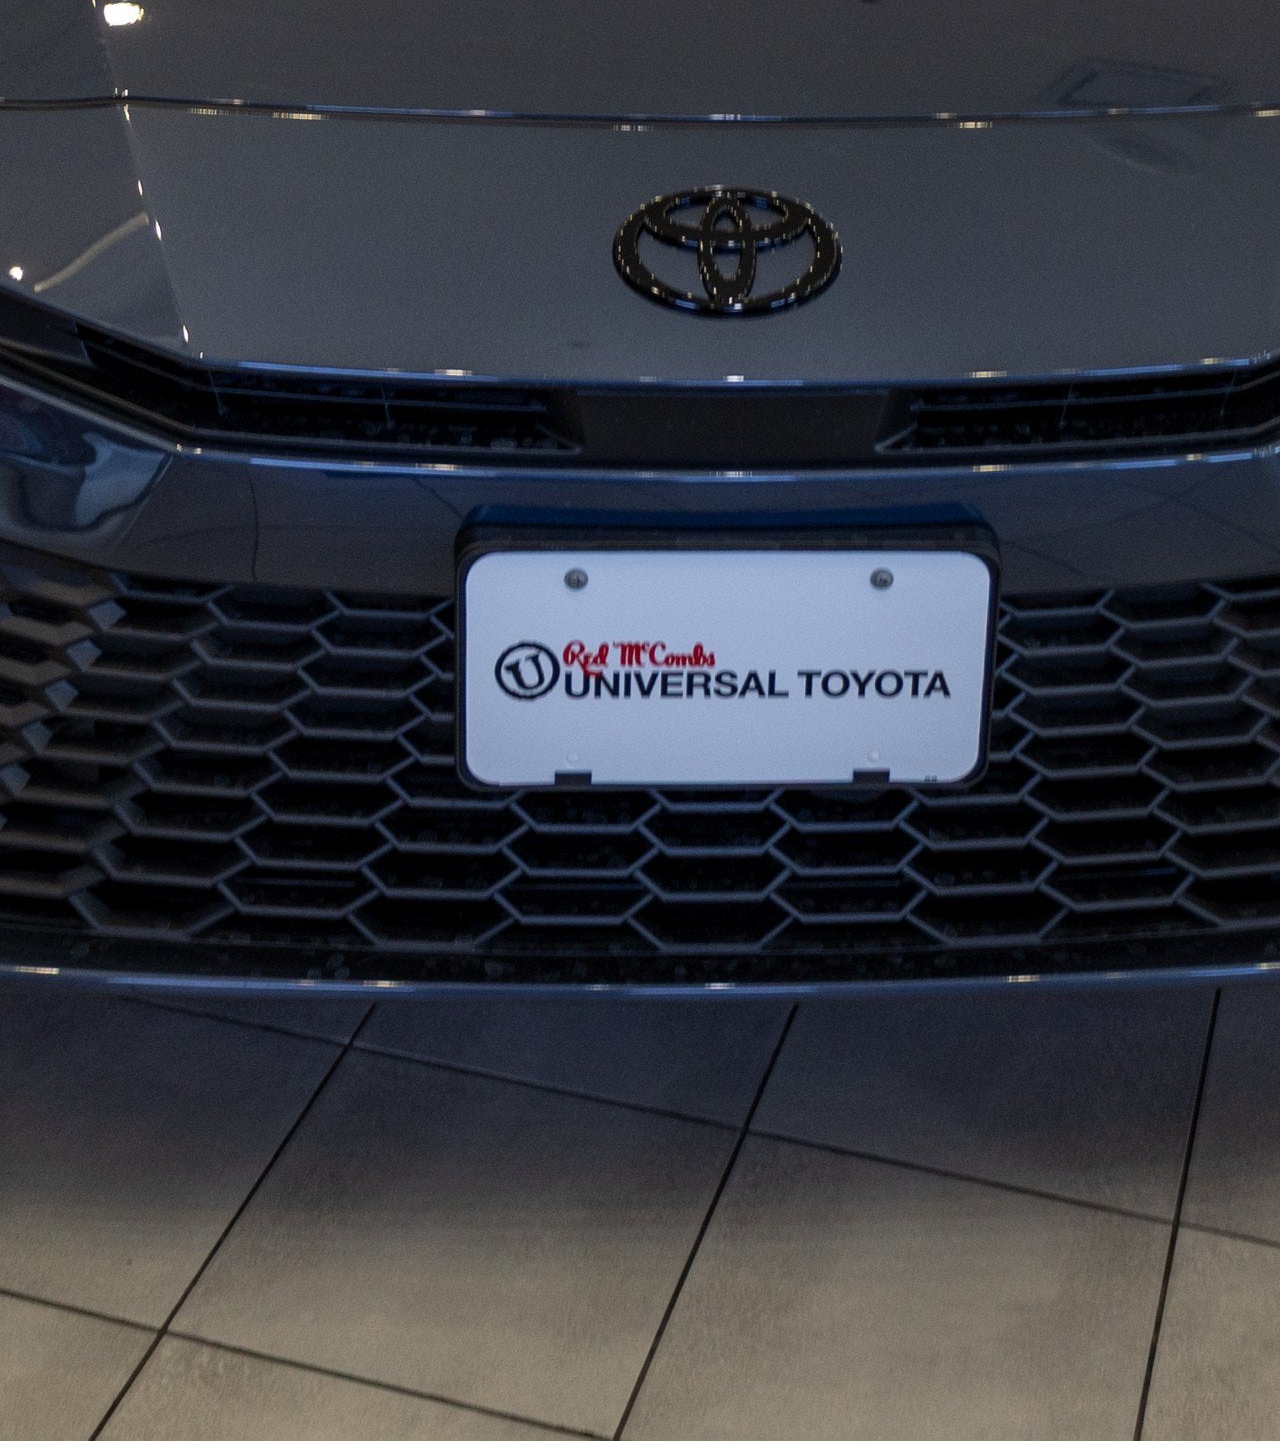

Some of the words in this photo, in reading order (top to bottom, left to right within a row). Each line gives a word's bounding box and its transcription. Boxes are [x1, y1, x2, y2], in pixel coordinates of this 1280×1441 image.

[563, 640, 610, 675] Red
[612, 640, 717, 669] McCombs
[563, 669, 790, 700] UNIVERSAL
[797, 669, 952, 700] TOYOTA
